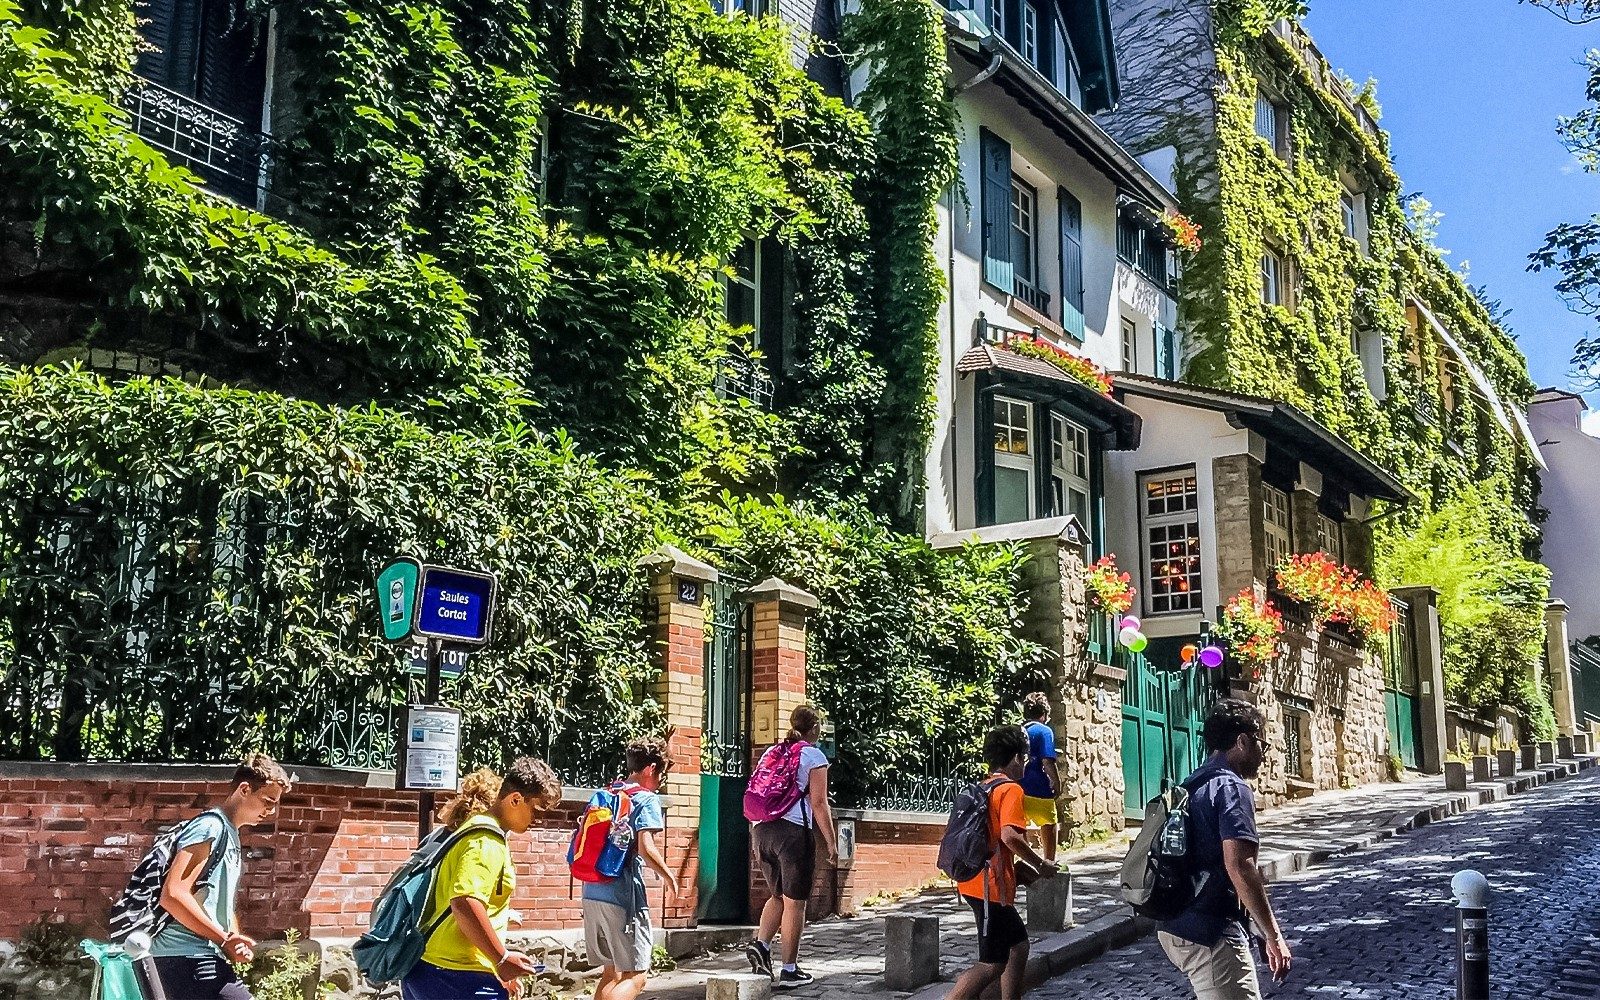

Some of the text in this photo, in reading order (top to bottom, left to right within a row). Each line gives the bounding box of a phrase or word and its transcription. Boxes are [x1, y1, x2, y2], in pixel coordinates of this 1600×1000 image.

[439, 590, 470, 605] Saules
[681, 584, 696, 600] 22
[437, 606, 468, 621] Cortot
[411, 645, 465, 666] COTOT
